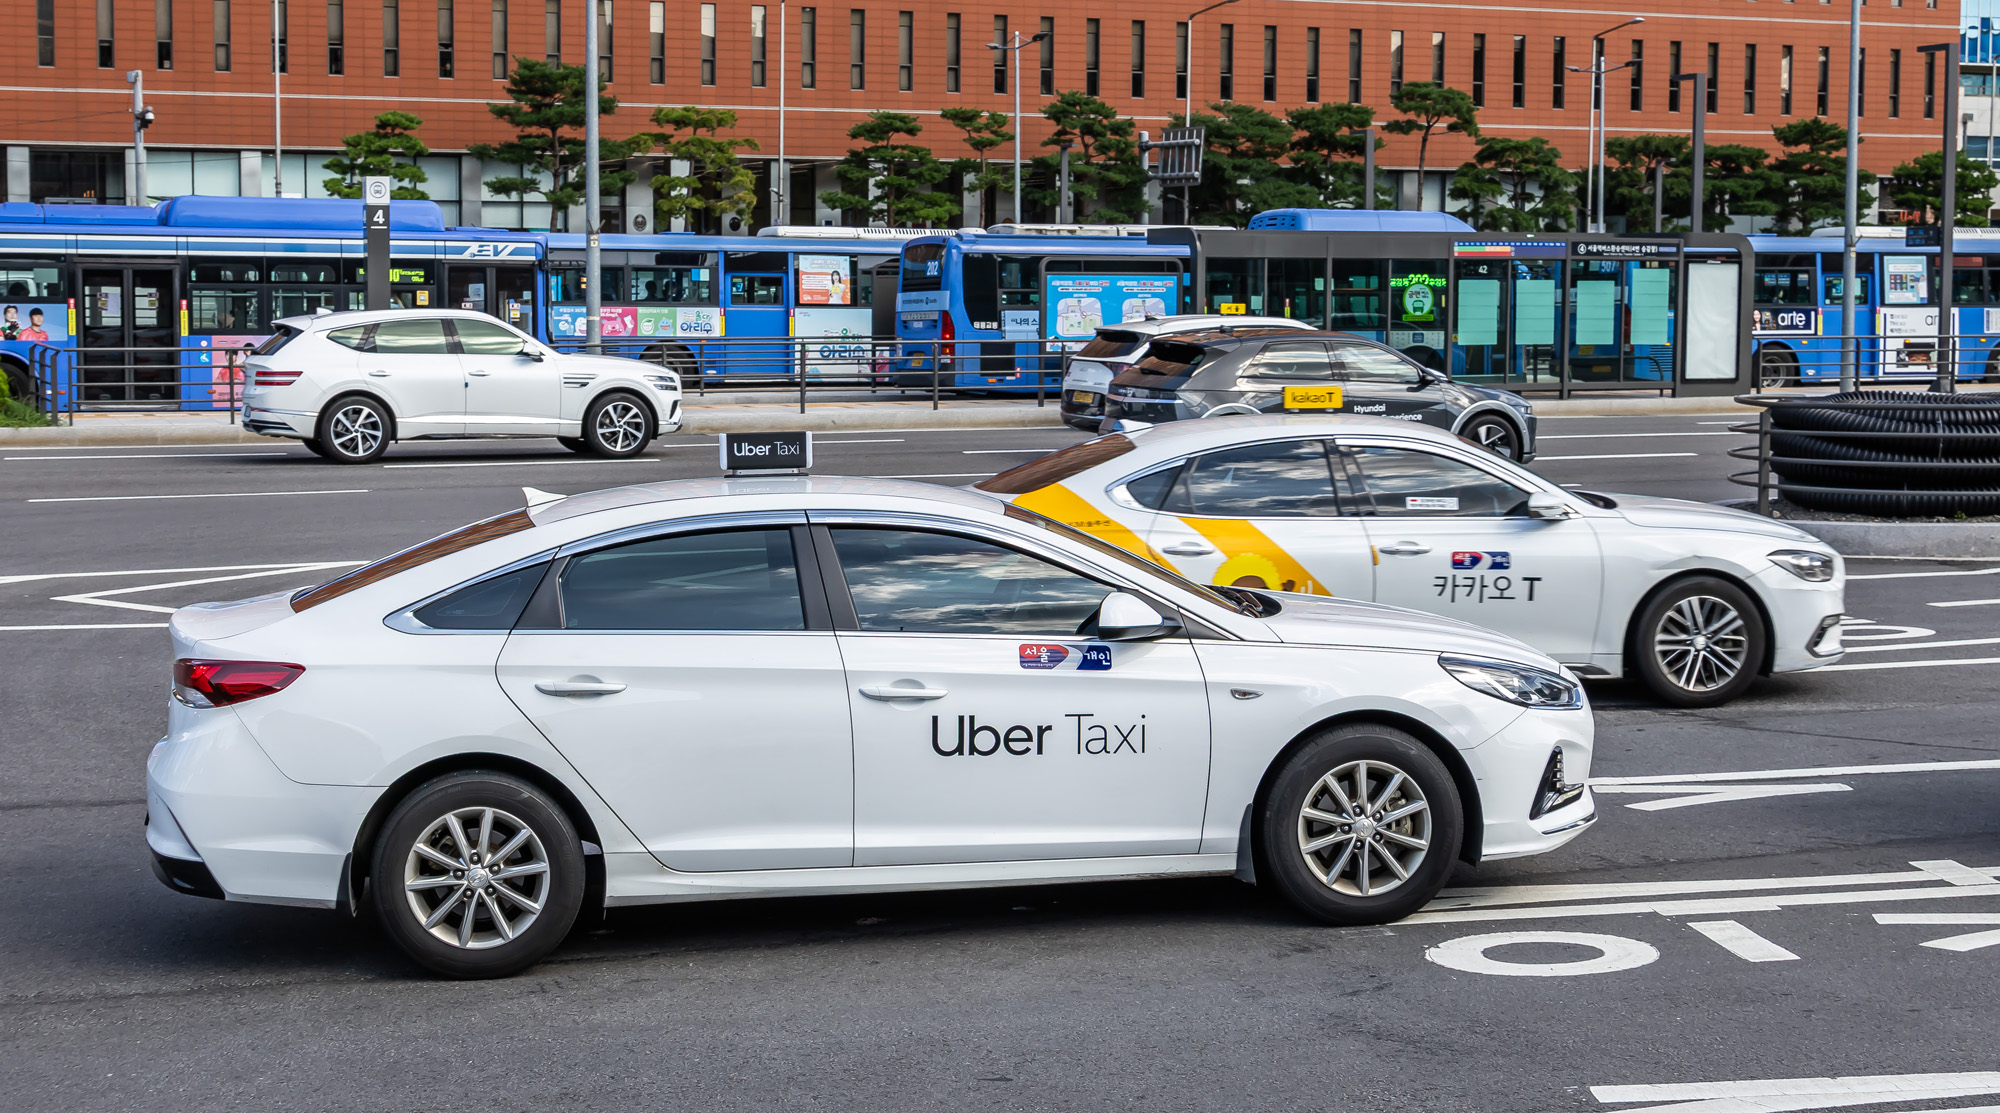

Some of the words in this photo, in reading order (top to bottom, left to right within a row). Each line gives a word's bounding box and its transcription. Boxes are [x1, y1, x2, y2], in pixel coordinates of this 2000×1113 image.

[373, 209, 385, 224] 4
[470, 244, 510, 258] EV
[926, 261, 939, 276] 202
[1478, 265, 1488, 274] 42
[1601, 261, 1617, 272] 507
[1777, 311, 1806, 326] arte
[680, 322, 713, 335] 아리수
[1354, 404, 1386, 414] Hyundai
[1381, 413, 1423, 421] perience
[733, 442, 771, 456] Uber
[773, 441, 800, 455] Taxi
[1433, 574, 1516, 603] 카카오
[1522, 577, 1543, 601] T
[1024, 646, 1051, 663] 서울
[1083, 650, 1111, 665] 개인
[931, 714, 1053, 757] Uber
[1064, 713, 1146, 755] Taxi
